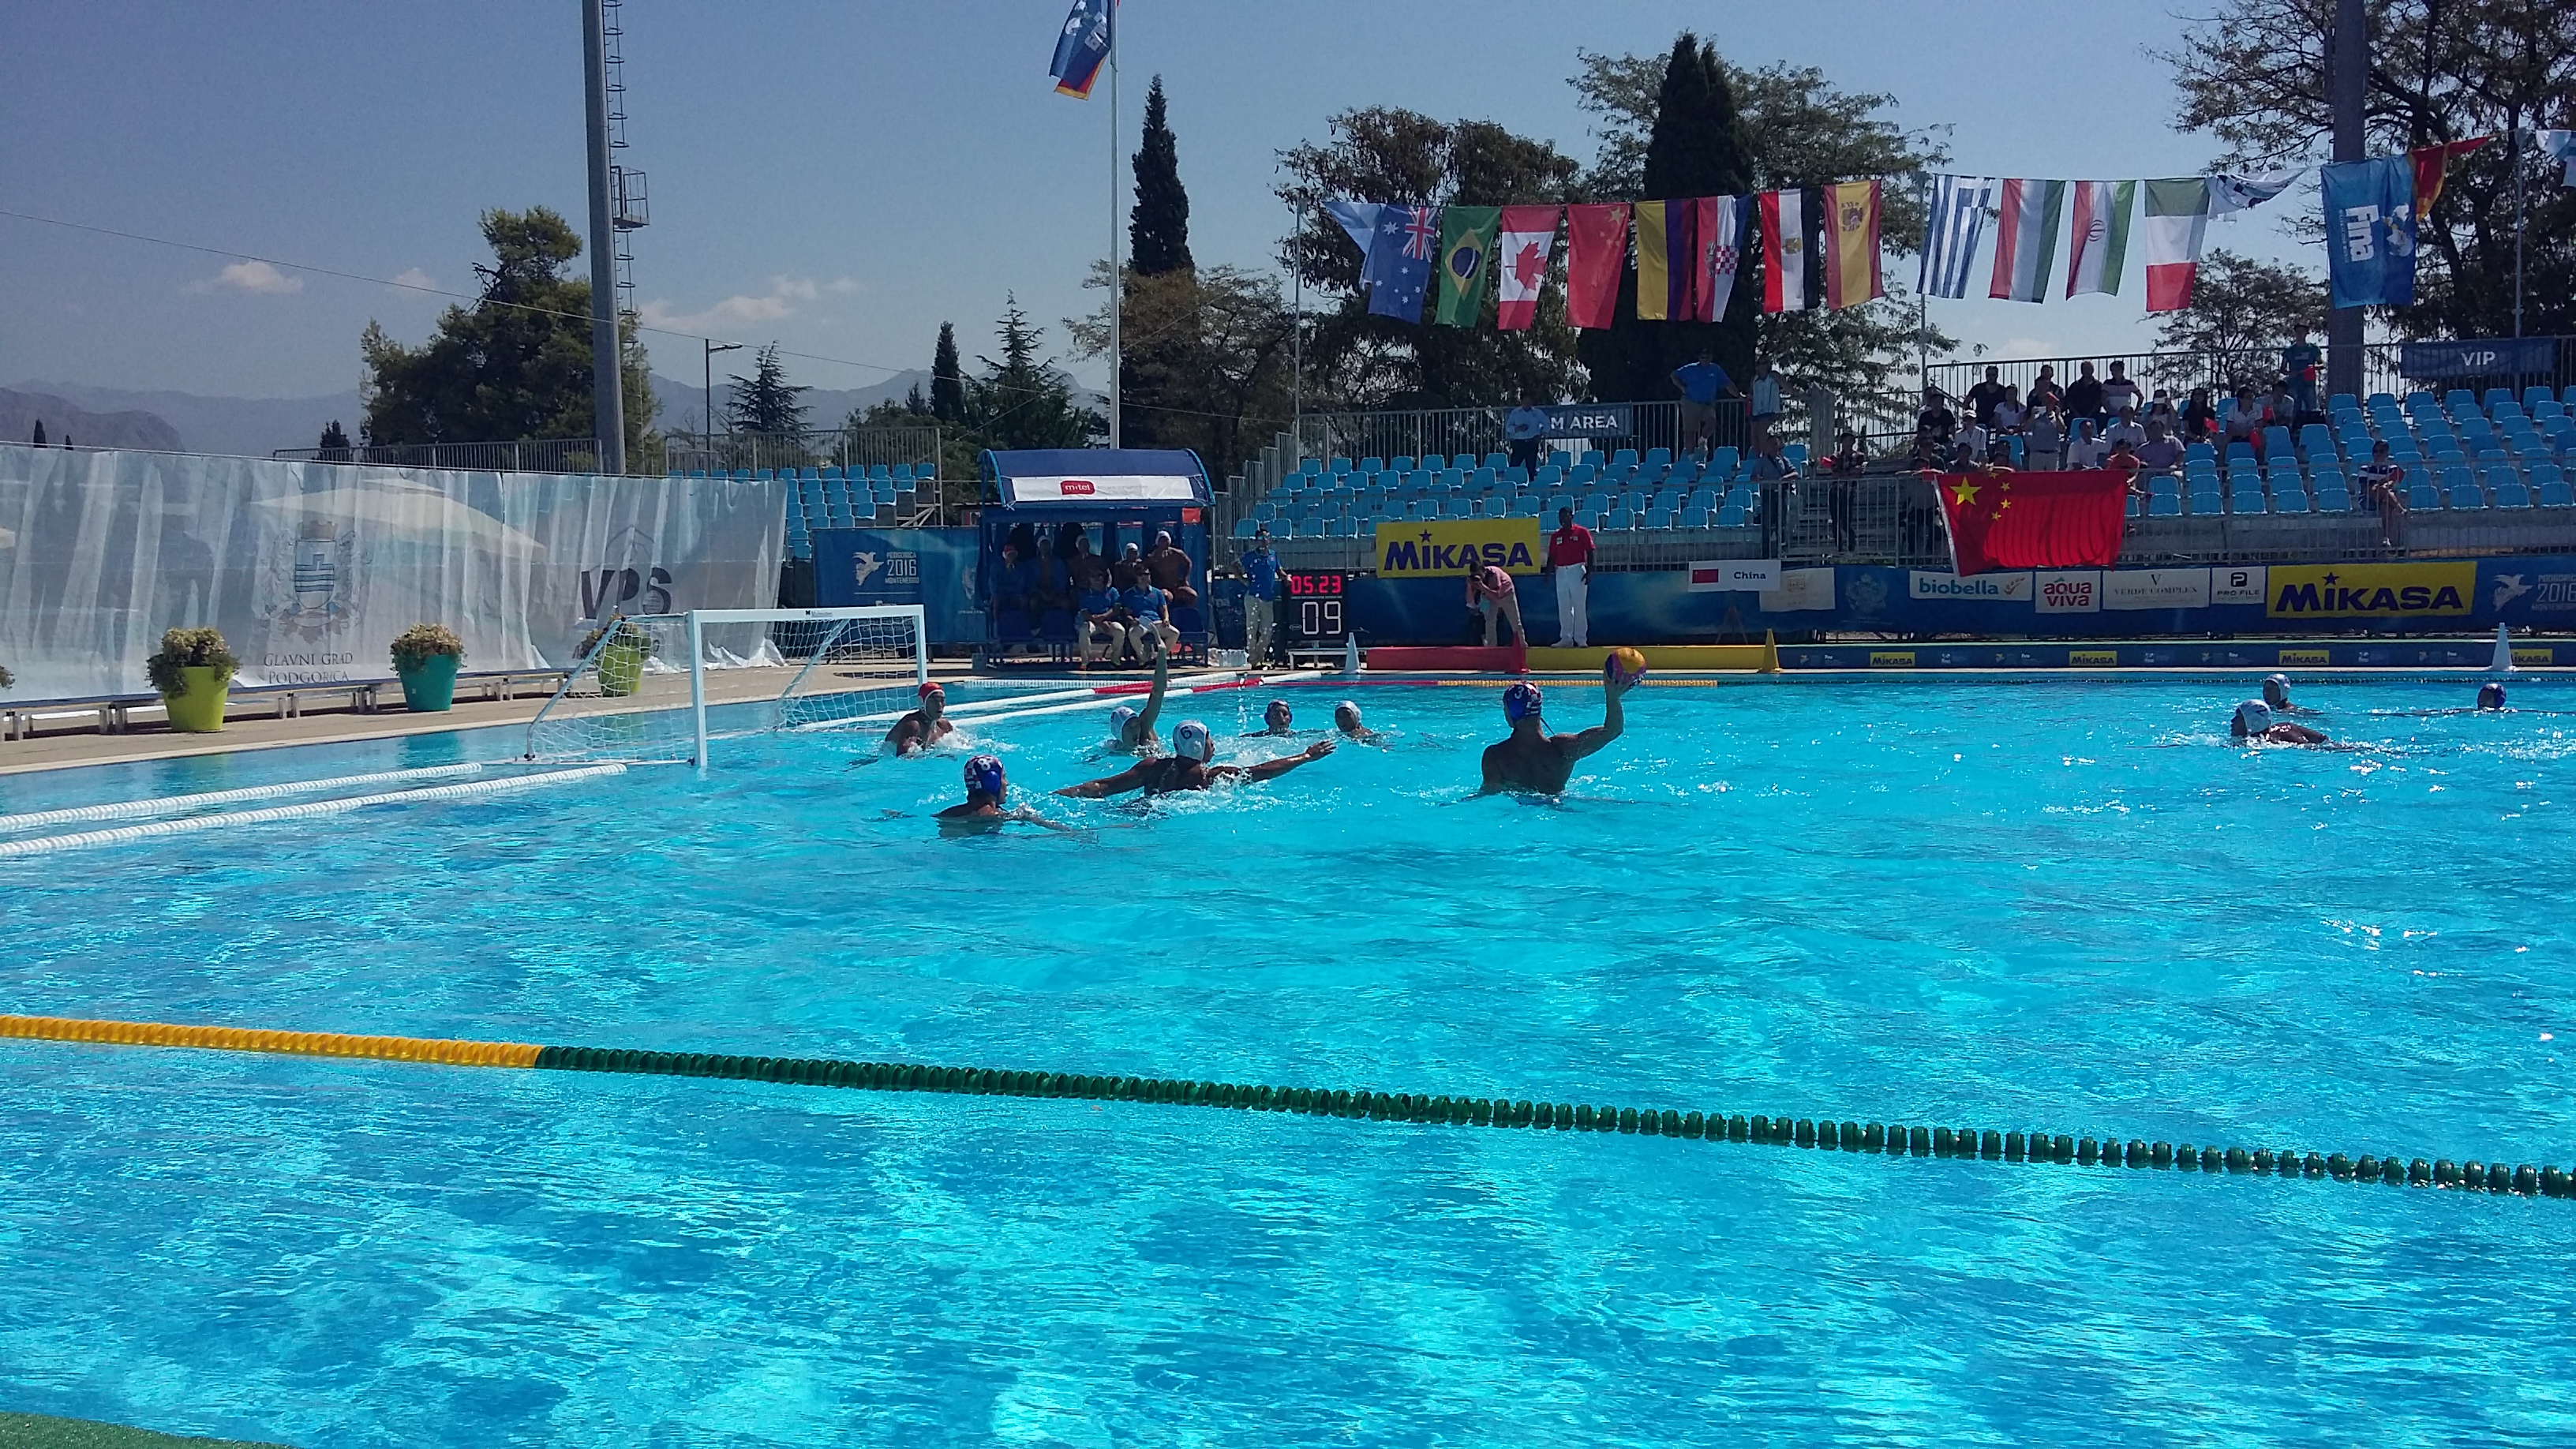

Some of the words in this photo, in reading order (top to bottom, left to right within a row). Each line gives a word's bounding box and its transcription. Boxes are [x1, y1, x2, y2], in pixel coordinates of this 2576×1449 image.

[2461, 351, 2496, 366] VIP
[1570, 414, 1618, 429] AREA
[887, 559, 916, 576] 2016
[1733, 571, 1766, 580] China
[2151, 574, 2162, 586] V
[1919, 577, 1999, 595] biobella
[581, 567, 672, 620] VPS
[2046, 594, 2090, 607] viva
[1302, 601, 1341, 635] 09
[264, 653, 315, 667] GLAVNI
[321, 652, 354, 665] GRAD
[268, 670, 349, 683] PODGORICA
[1514, 686, 1525, 699] 3
[1180, 725, 1193, 739] 6
[978, 757, 992, 771] 8
